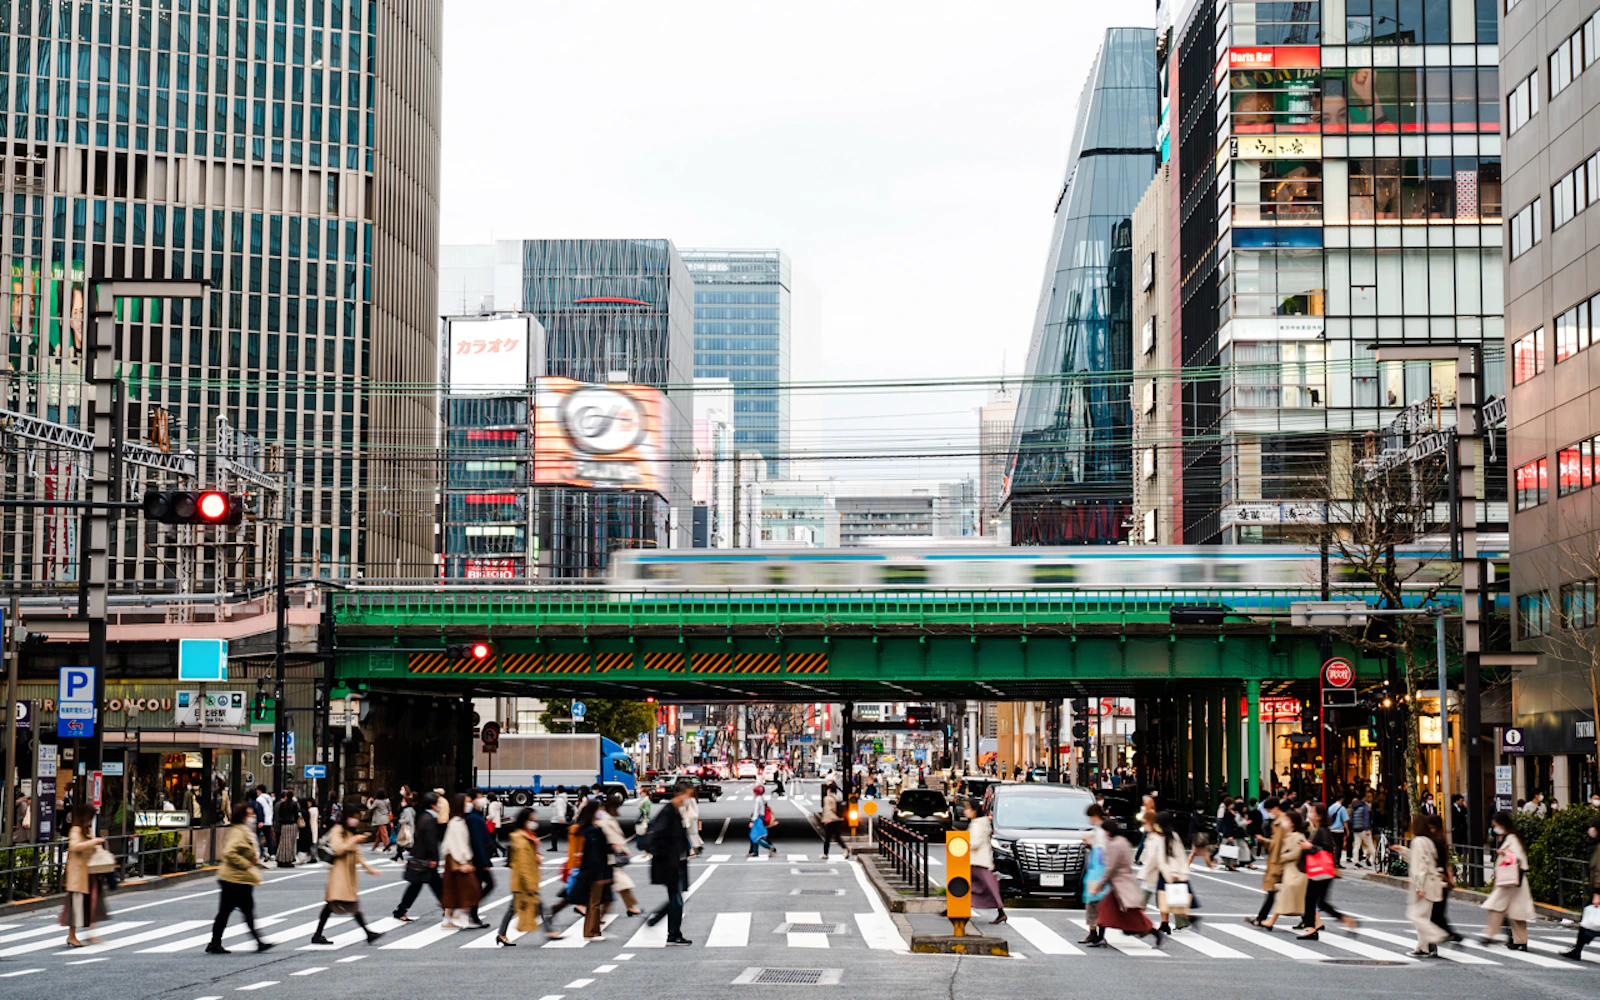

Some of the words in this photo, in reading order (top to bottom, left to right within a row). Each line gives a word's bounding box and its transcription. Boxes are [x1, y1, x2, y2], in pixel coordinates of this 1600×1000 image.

[1231, 52, 1255, 63] Darts
[1256, 52, 1273, 63] Bar
[456, 338, 520, 355] カラオケ
[1330, 669, 1348, 680] 消火栓
[67, 671, 88, 698] P
[1100, 697, 1113, 717] 5
